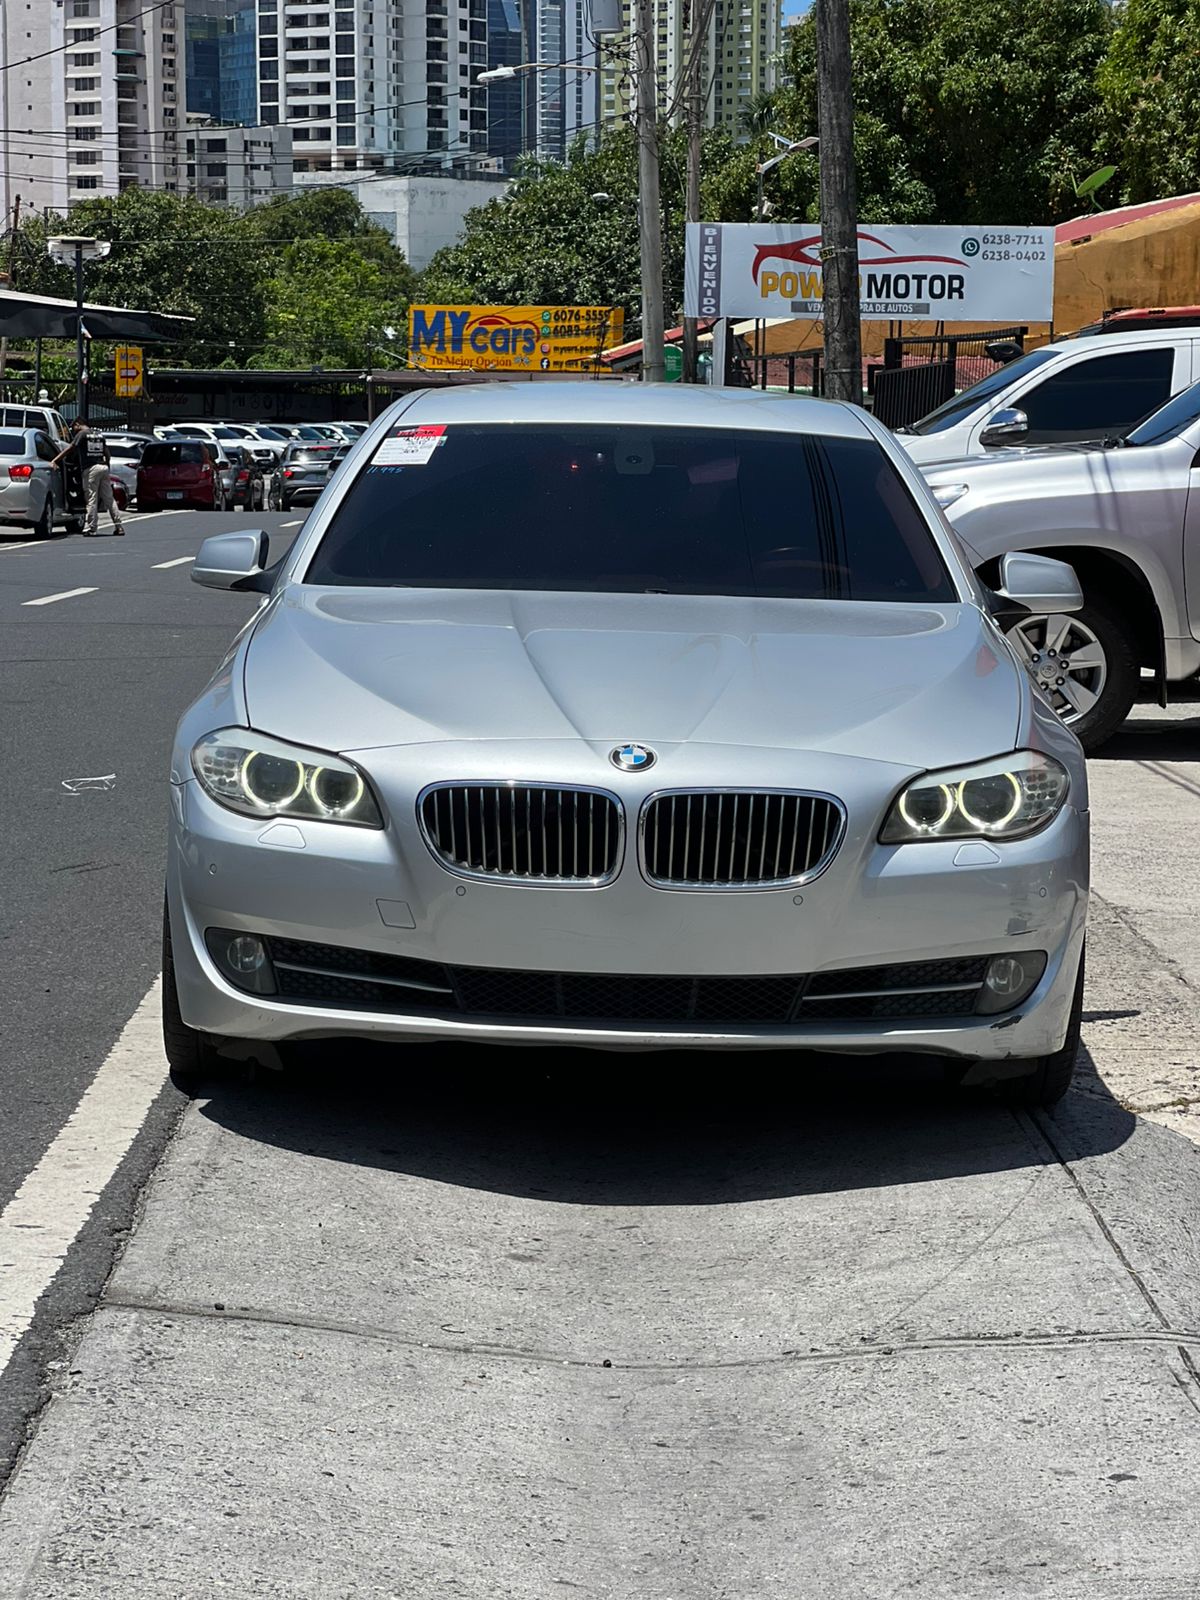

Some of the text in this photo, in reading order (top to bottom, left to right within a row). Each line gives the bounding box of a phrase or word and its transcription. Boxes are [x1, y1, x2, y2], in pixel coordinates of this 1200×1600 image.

[982, 234, 1044, 246] 6238-7711
[981, 250, 1046, 262] 6238-0402
[702, 227, 718, 314] BIENVENIDO
[761, 271, 965, 300] POW MOTOR
[876, 303, 886, 313] DE
[887, 303, 913, 313] AUTOS
[412, 310, 471, 354] MY
[470, 326, 536, 354] cars
[431, 355, 512, 369] Tu Mejor Opción
